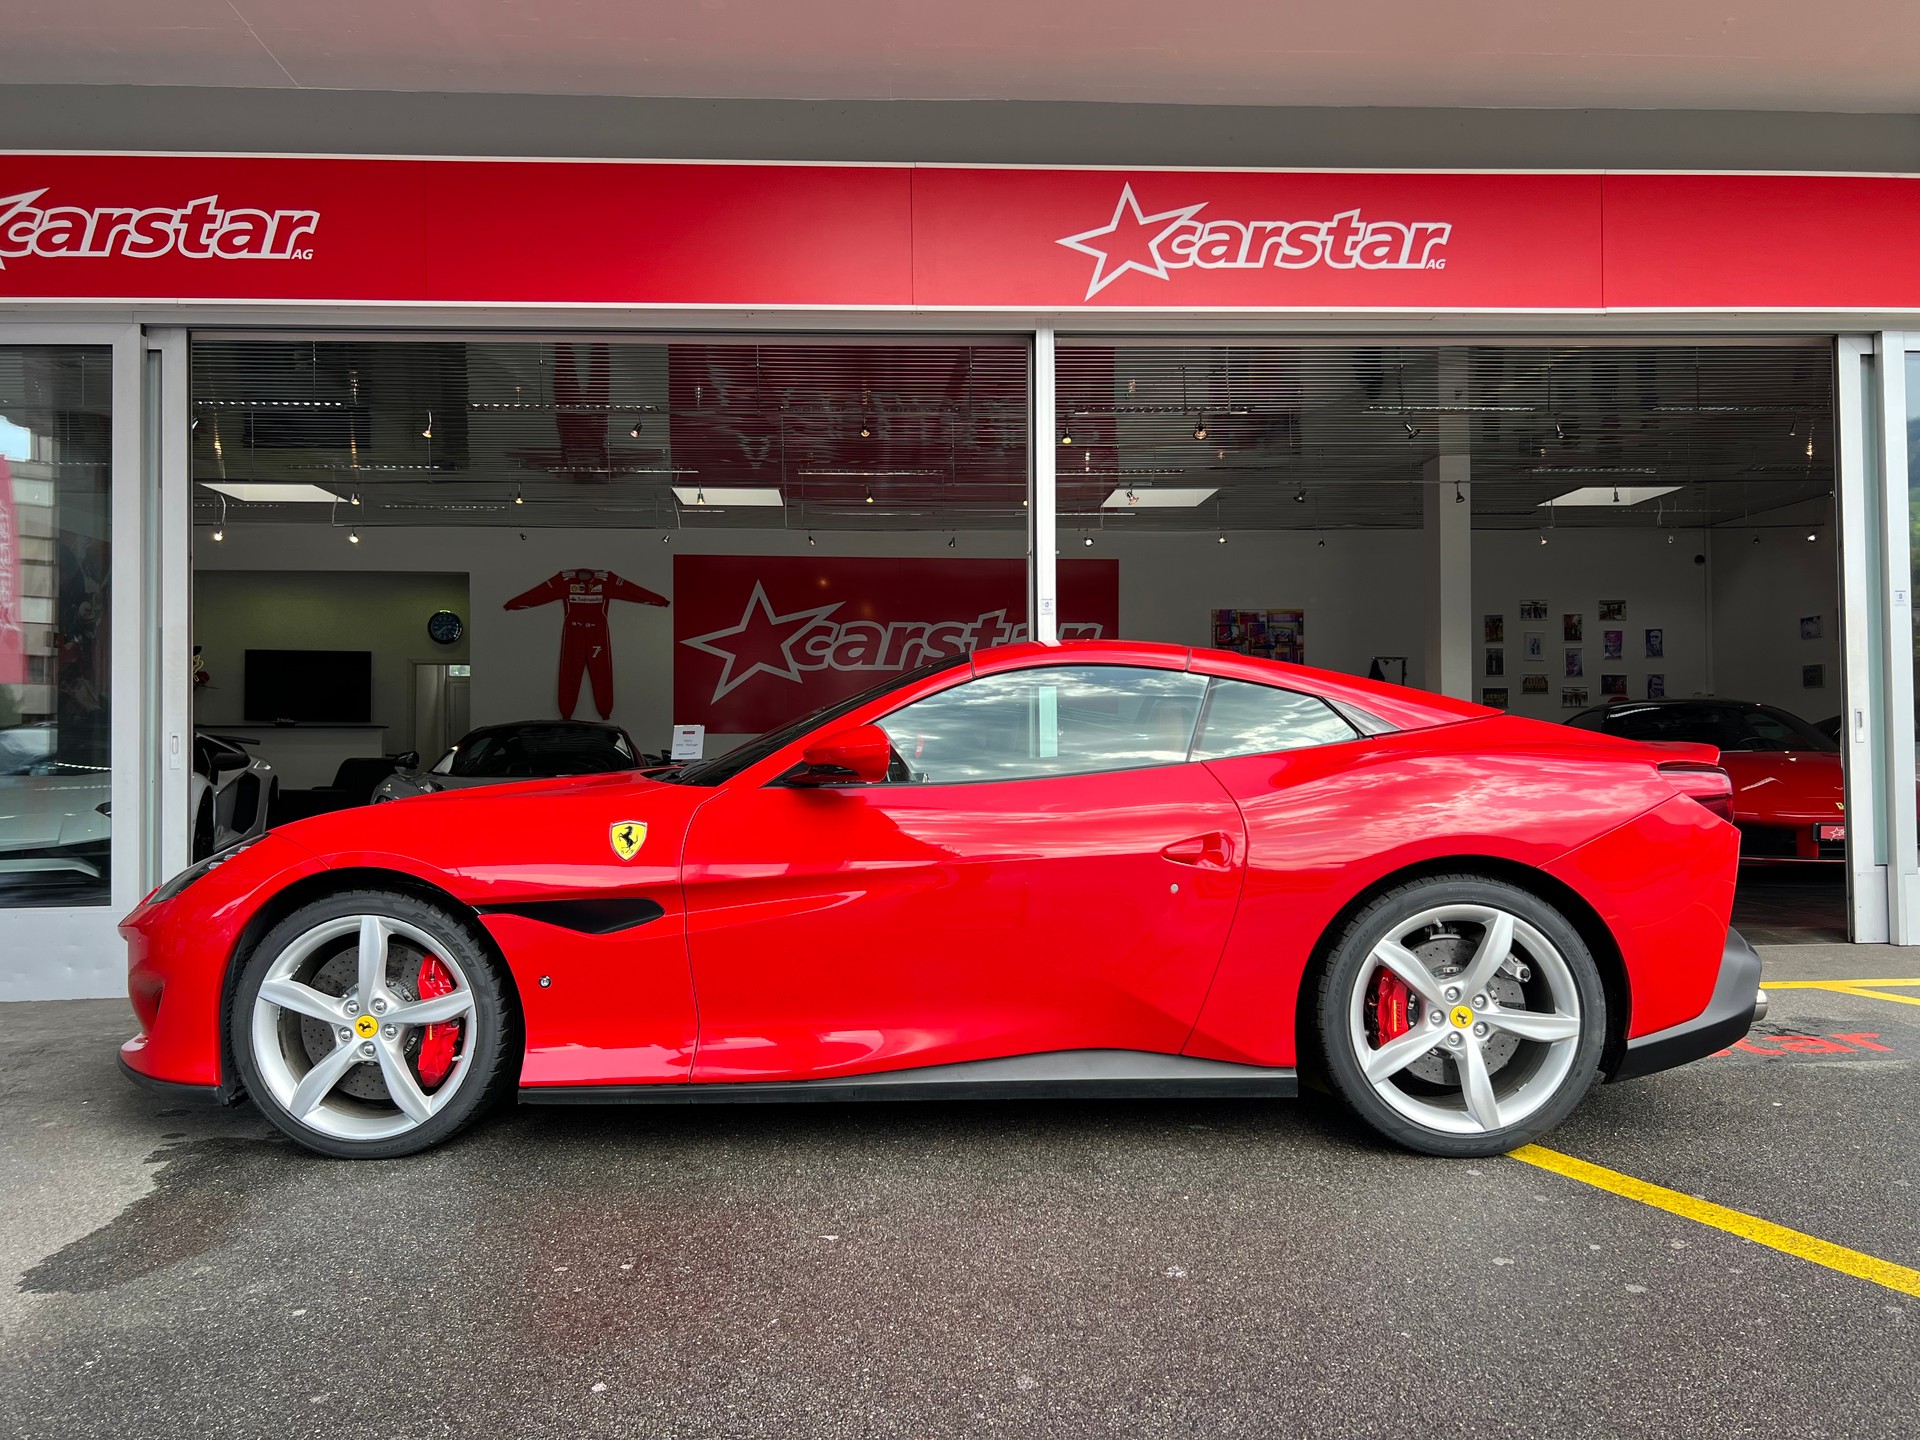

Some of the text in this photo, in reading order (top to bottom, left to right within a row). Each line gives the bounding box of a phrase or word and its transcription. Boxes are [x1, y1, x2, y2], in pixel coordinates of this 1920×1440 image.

[0, 195, 320, 260] carstar AG
[1152, 208, 1452, 270] carstar AG
[592, 645, 602, 658] 7
[428, 921, 476, 967] ZERO
